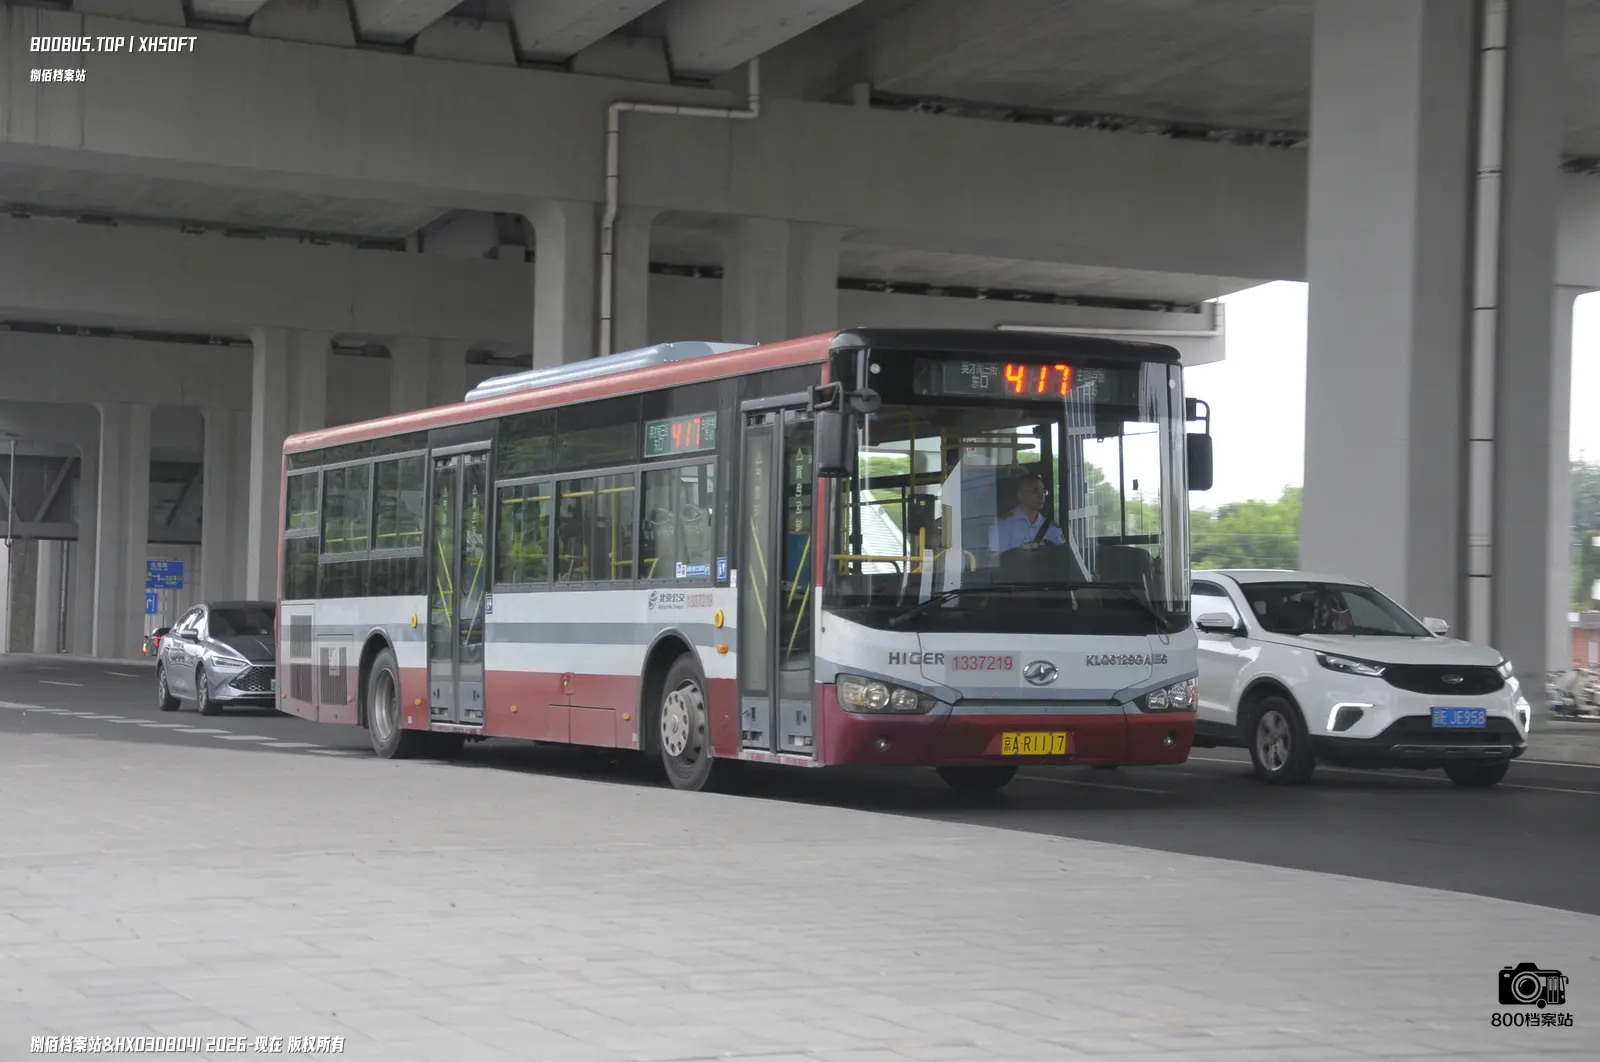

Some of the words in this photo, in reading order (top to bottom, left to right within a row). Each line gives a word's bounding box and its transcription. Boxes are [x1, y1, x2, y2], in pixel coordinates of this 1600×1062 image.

[1004, 363, 1070, 395] 417
[671, 417, 702, 449] 417
[659, 593, 686, 603] 北京公交
[888, 651, 945, 665] HIGER
[951, 655, 1013, 671] 1337219
